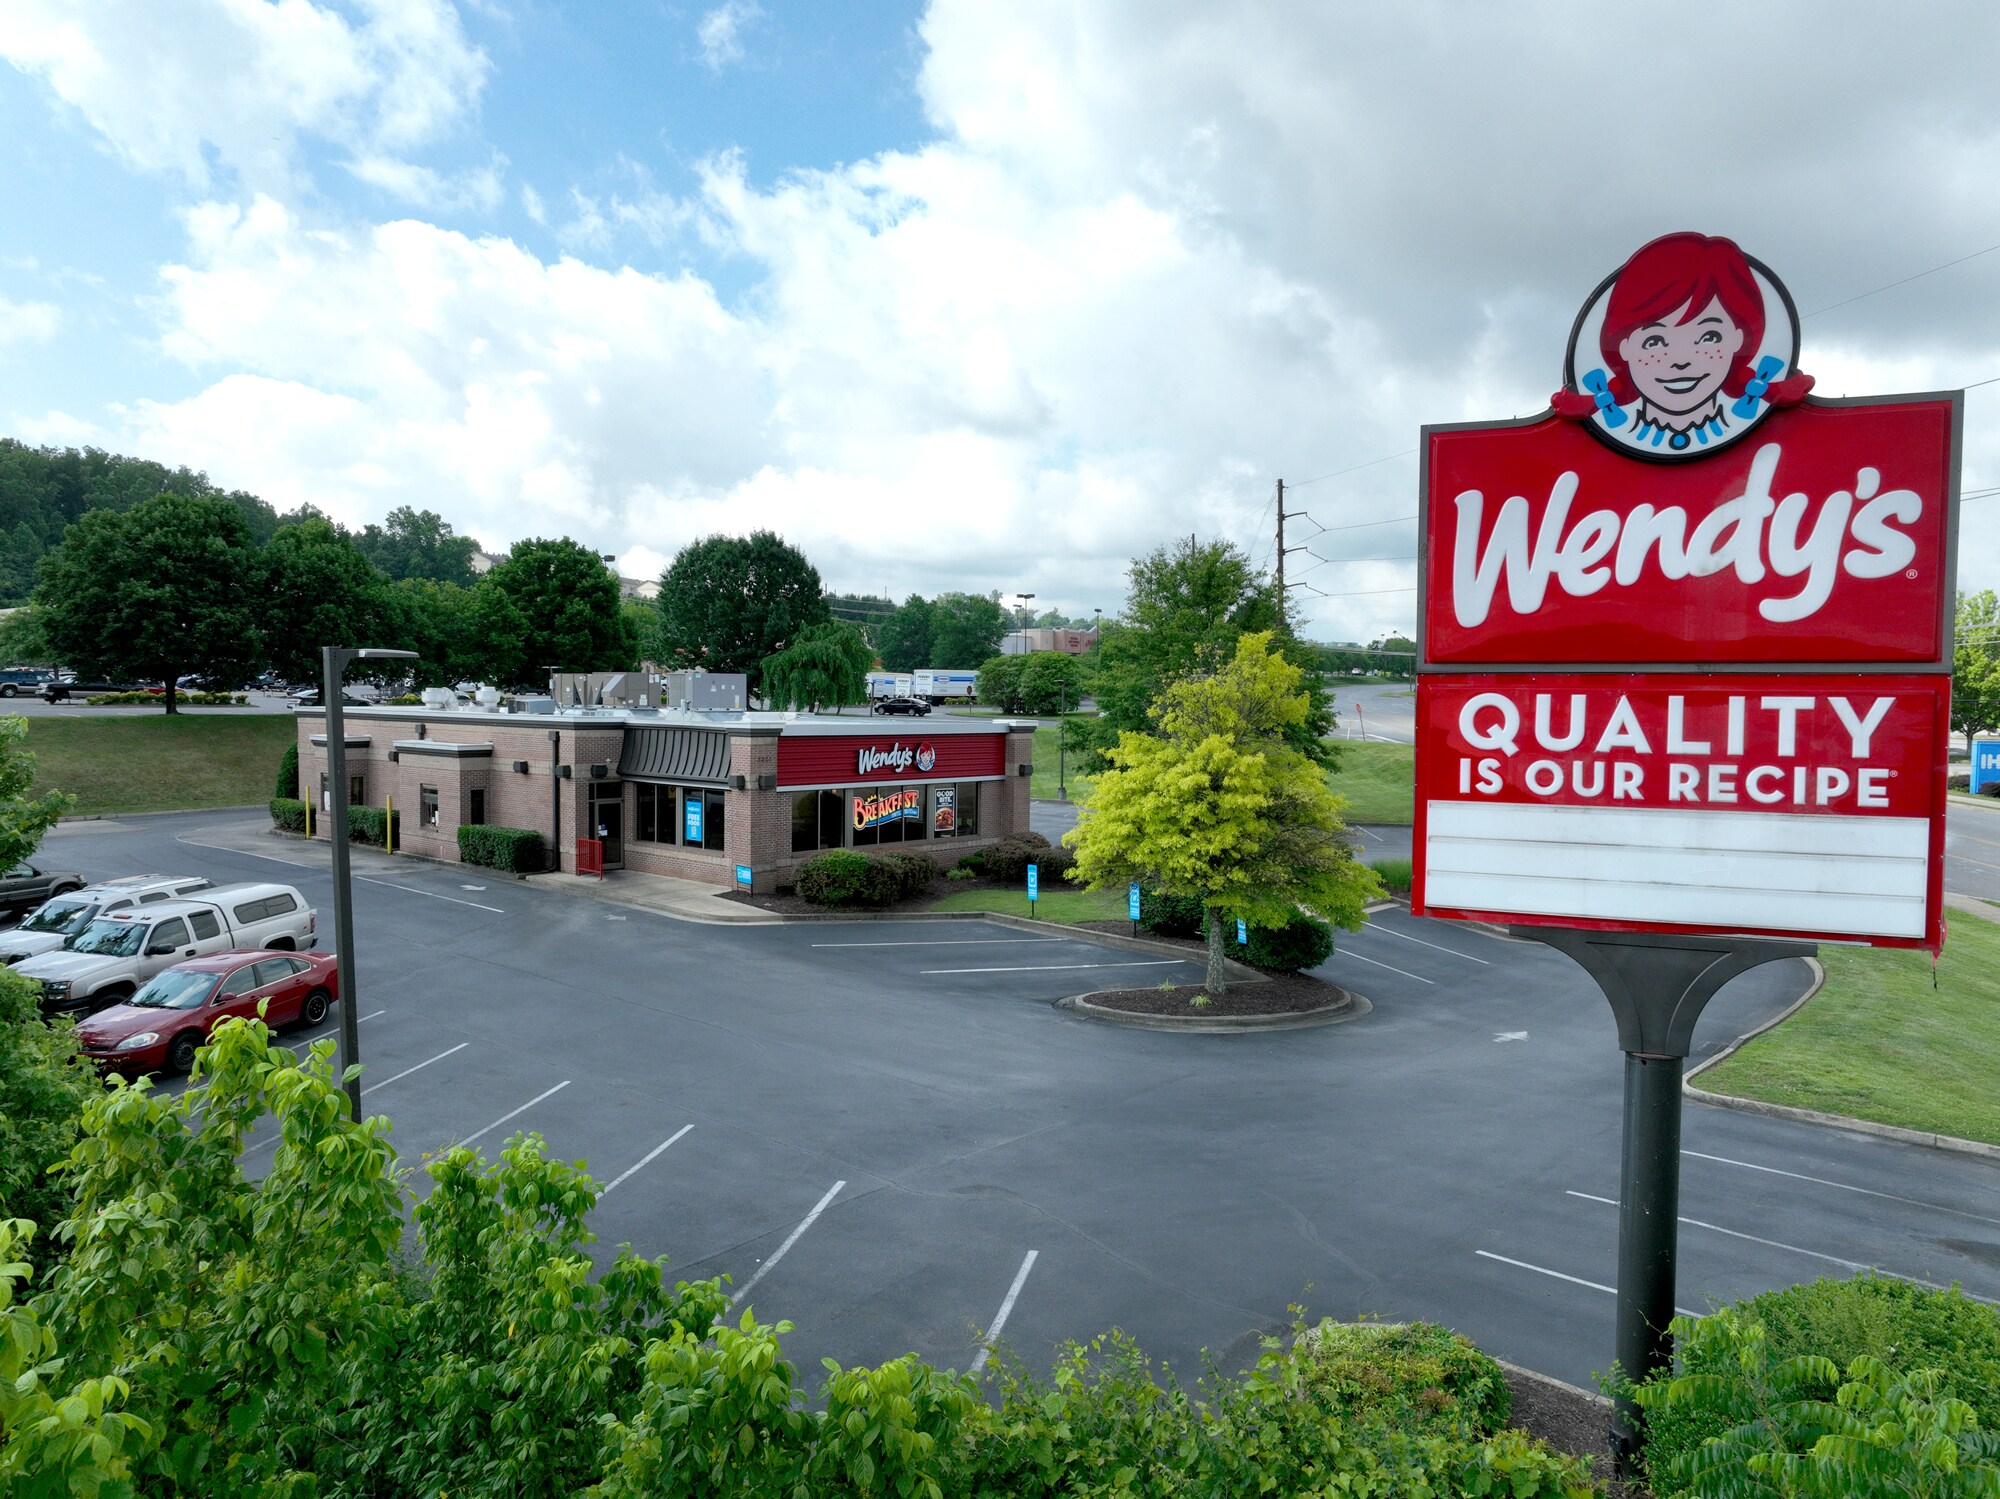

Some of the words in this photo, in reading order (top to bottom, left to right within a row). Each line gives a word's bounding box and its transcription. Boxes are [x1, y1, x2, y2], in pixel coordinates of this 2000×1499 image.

[1458, 692, 1896, 761] QUALITY
[859, 742, 913, 775] Wendy's
[936, 790, 954, 798] GOOD
[1459, 758, 1504, 795] IS
[1524, 760, 1644, 800] OUR
[853, 790, 918, 830] BREAKFAST
